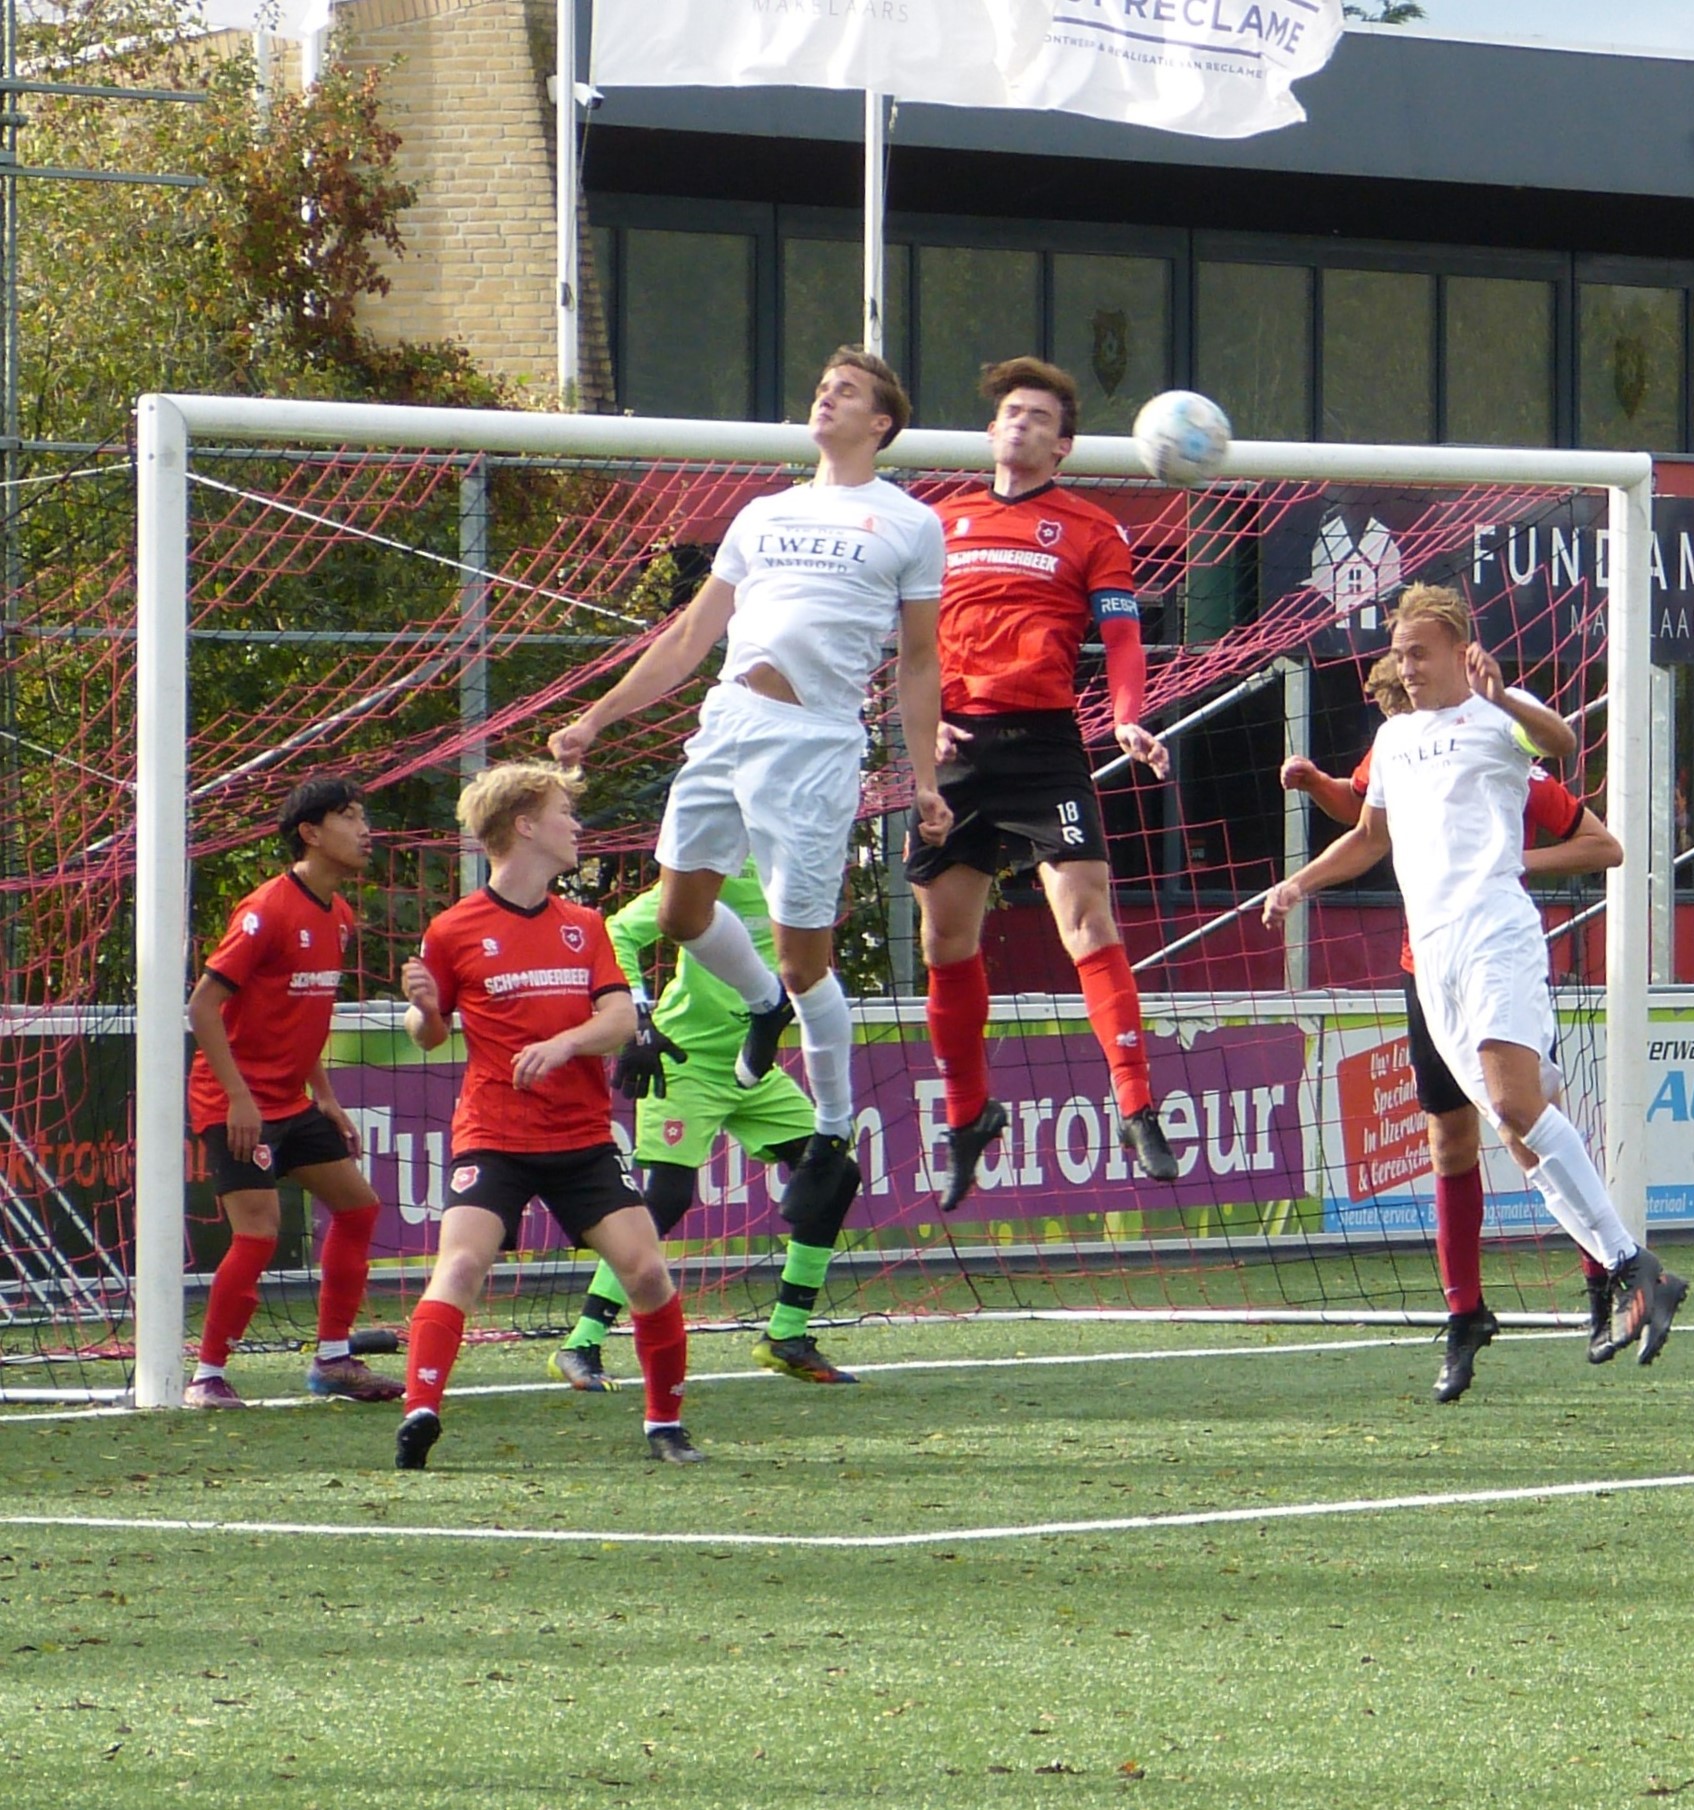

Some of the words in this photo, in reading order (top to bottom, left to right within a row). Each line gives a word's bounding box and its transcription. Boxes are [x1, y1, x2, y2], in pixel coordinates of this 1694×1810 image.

[758, 534, 866, 564] TWEEL
[1056, 800, 1079, 824] 18
[1646, 1193, 1686, 1213] teriaal
